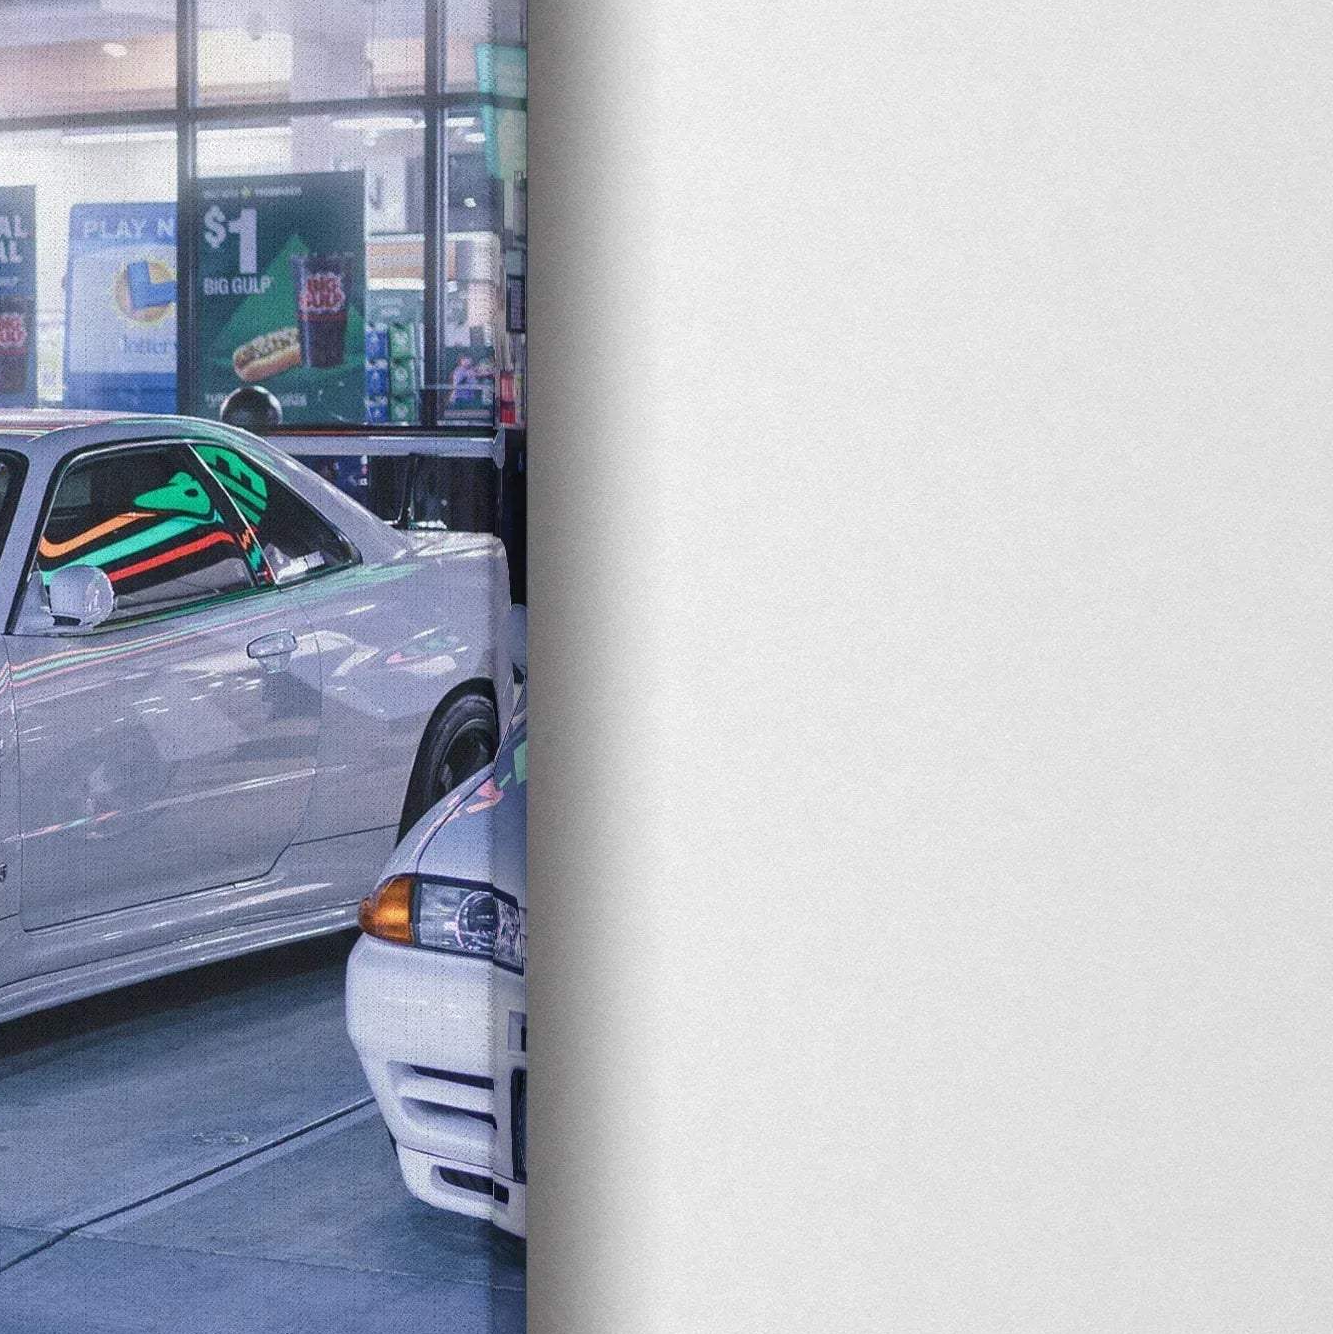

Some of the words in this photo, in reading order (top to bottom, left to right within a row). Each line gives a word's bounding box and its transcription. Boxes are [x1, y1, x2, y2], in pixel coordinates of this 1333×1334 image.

[84, 219, 146, 238] PLAY
[157, 218, 175, 237] N
[204, 205, 257, 274] $1
[204, 277, 229, 295] BIG
[232, 275, 272, 295] GULP
